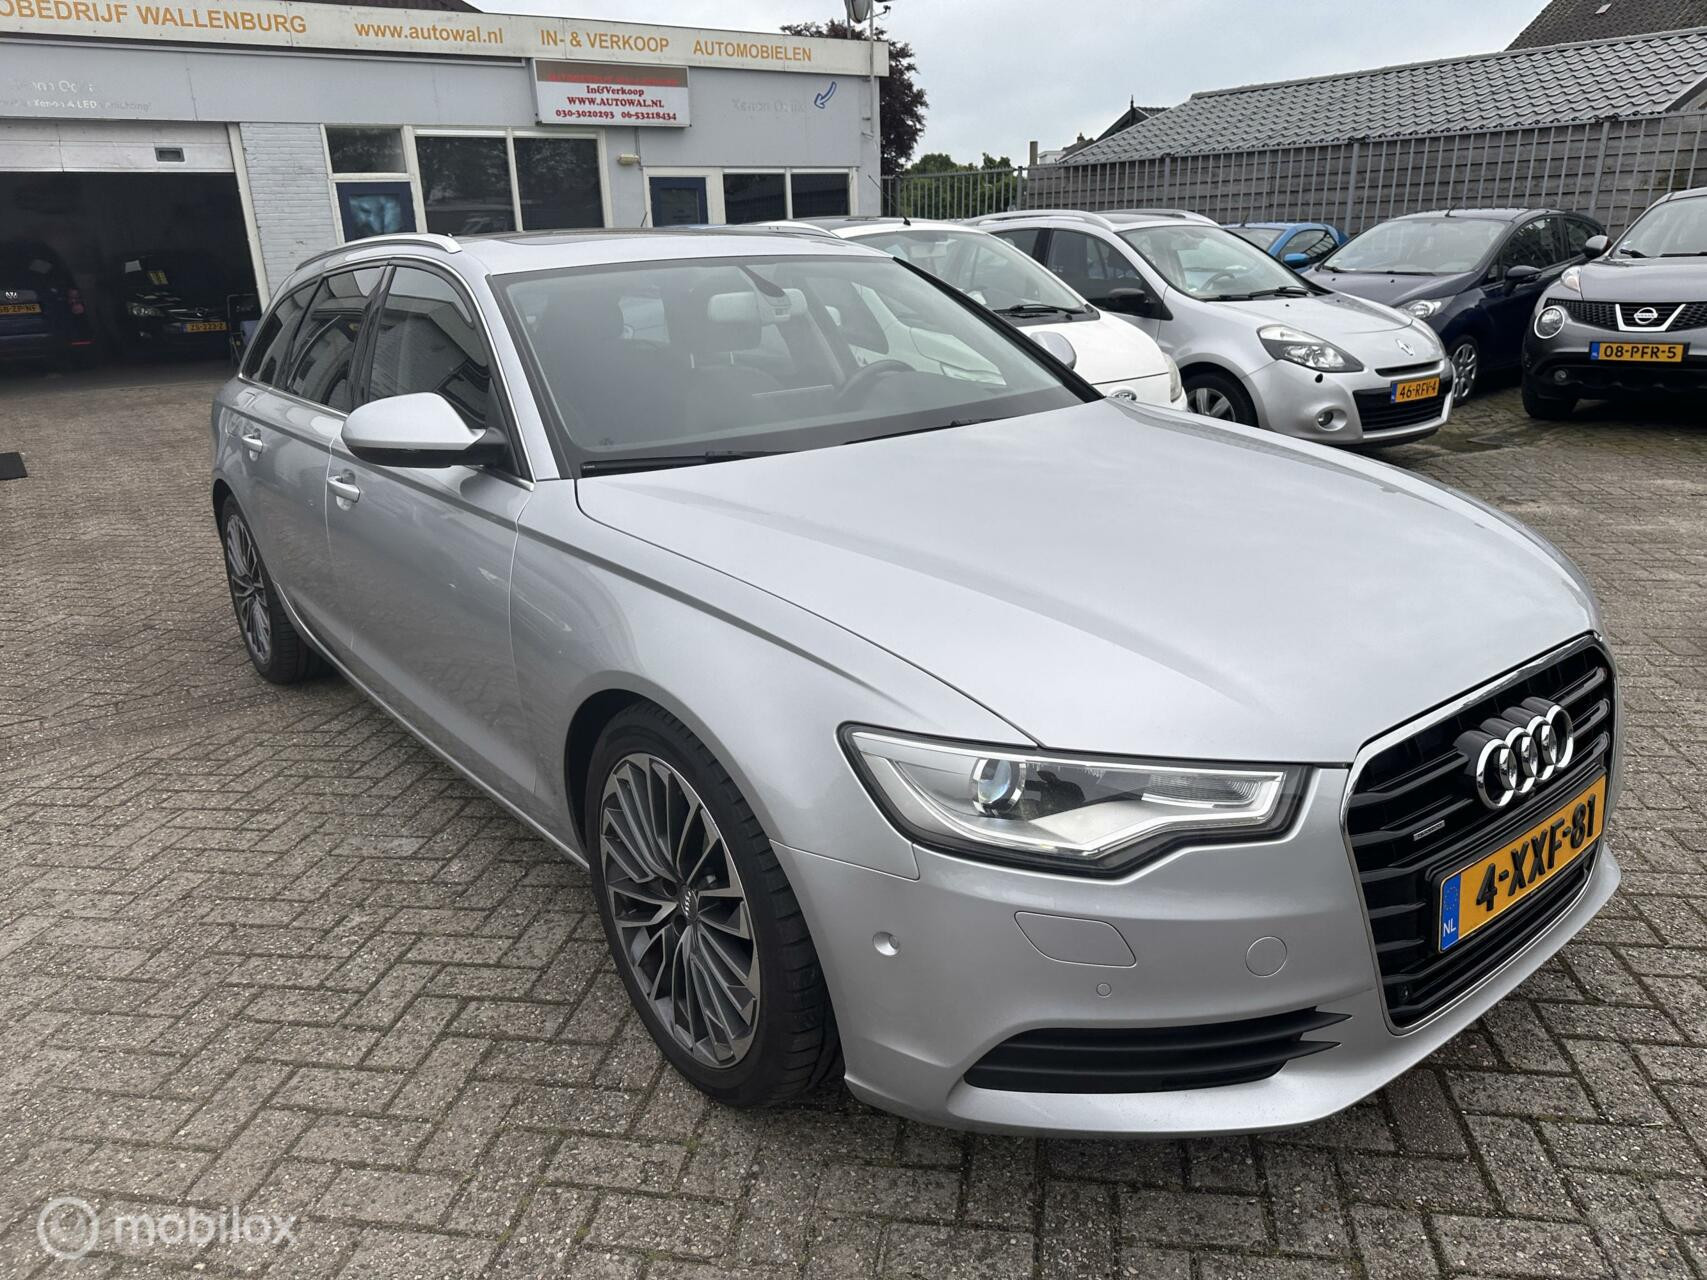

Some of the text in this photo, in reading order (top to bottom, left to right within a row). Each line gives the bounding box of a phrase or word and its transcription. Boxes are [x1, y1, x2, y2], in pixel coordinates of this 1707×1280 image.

[136, 5, 307, 34] WALLENBURG
[354, 23, 503, 44] www.autowal.nl
[570, 33, 582, 48] &
[588, 33, 669, 53] VERKOOP
[693, 40, 812, 61] AUTOMOBIELEN
[567, 96, 665, 108] WWW.AUTOWAL.NL
[555, 109, 677, 121] 030-3020293 06-53218434
[1603, 345, 1677, 359] 08-PFR-5
[1475, 793, 1597, 912] 4-XXF-81
[1442, 917, 1457, 937] NL
